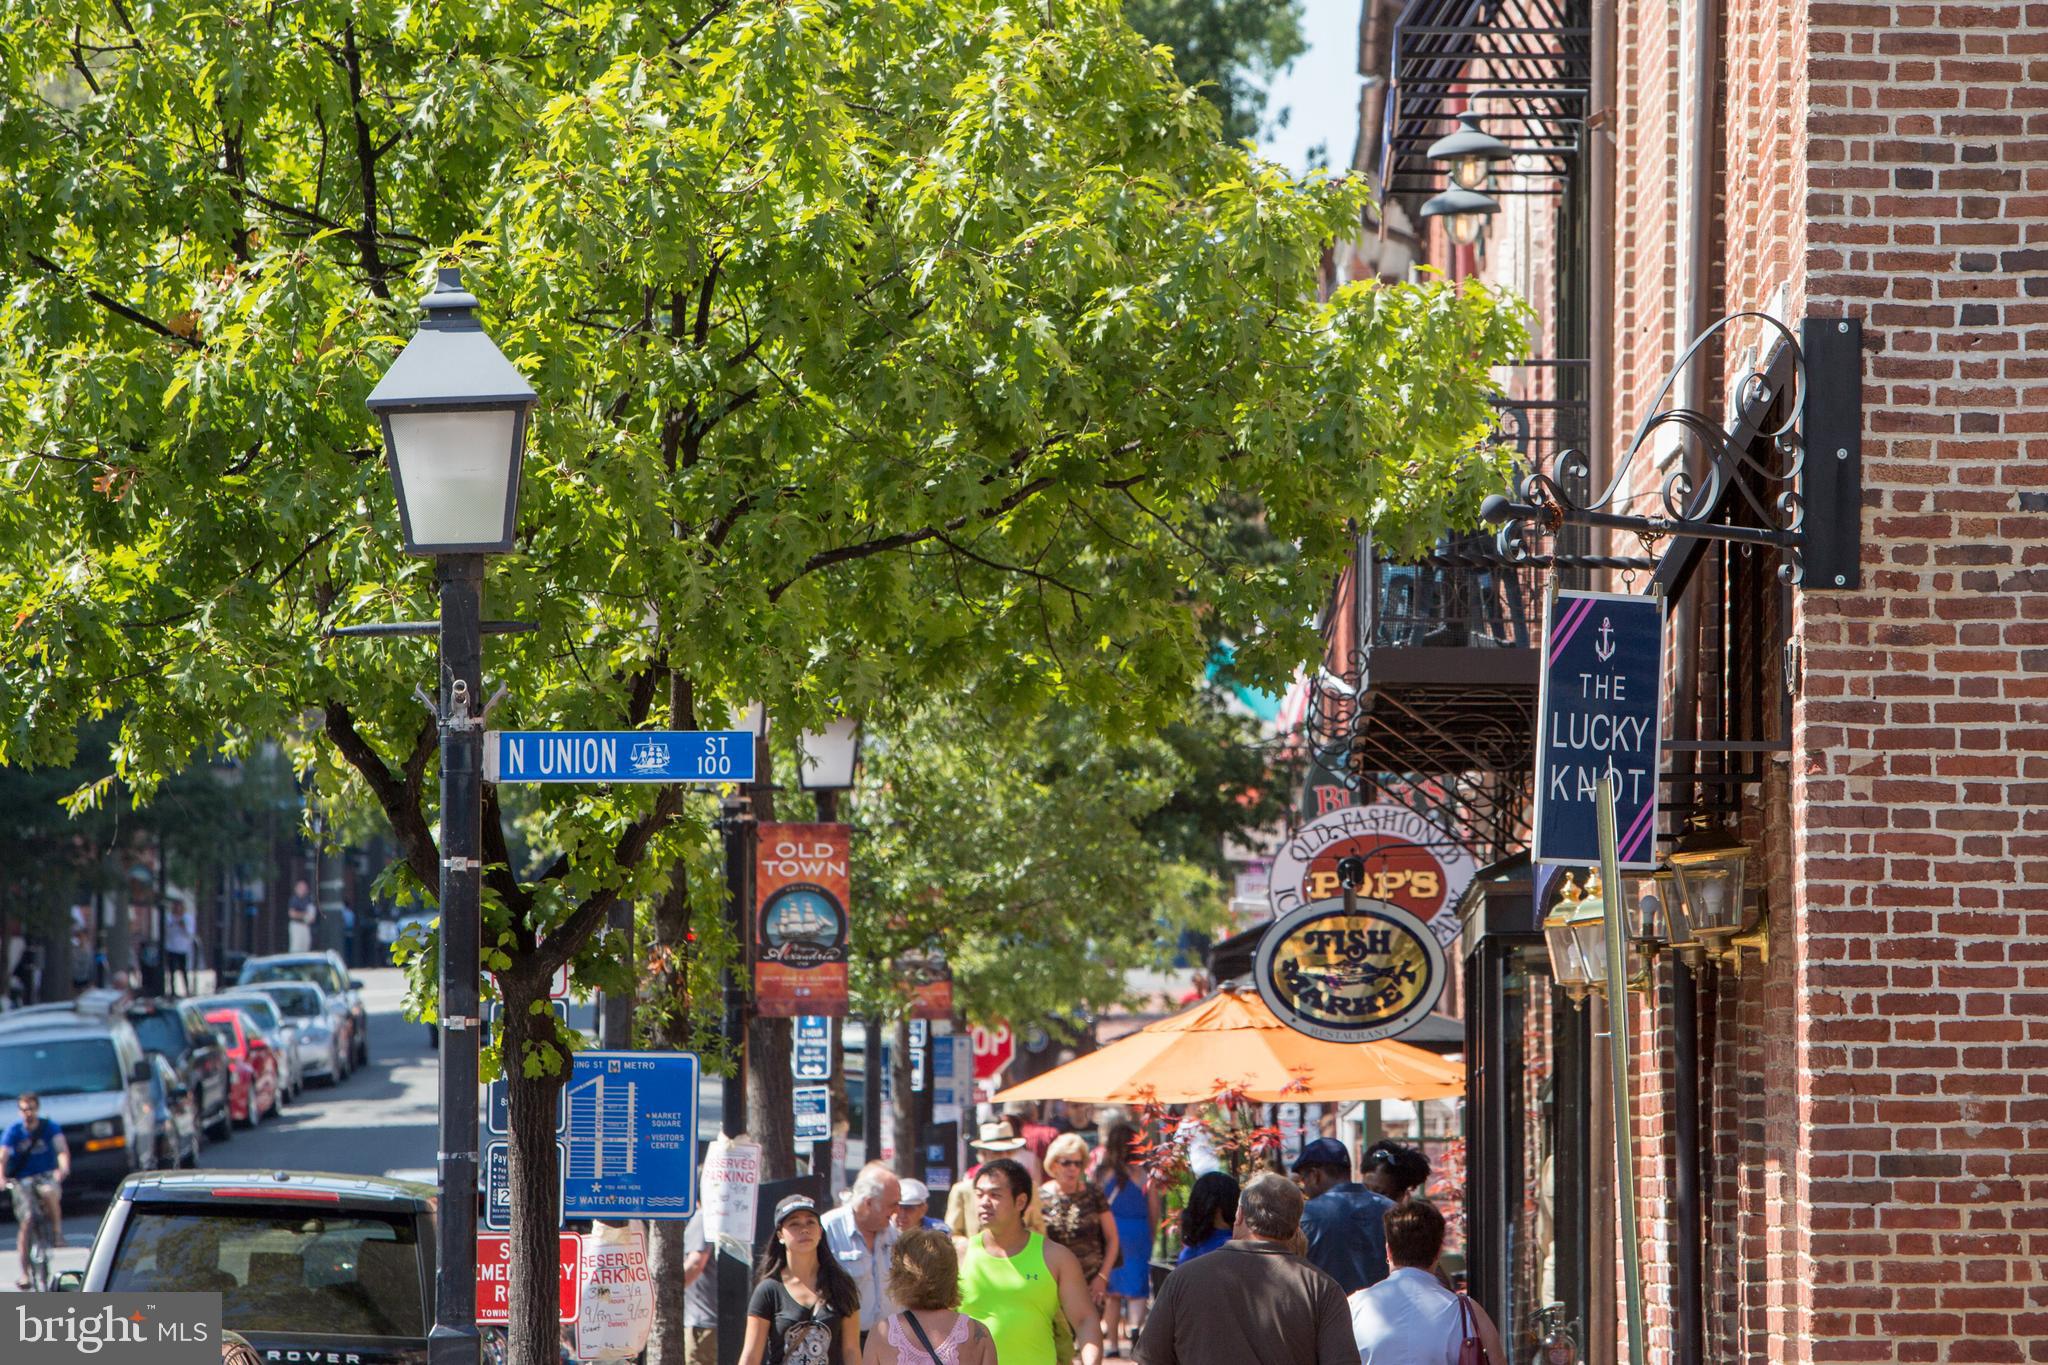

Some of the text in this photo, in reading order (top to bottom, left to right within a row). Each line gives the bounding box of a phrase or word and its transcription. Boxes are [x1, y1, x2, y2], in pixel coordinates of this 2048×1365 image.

[1579, 673, 1626, 701] THE
[1552, 711, 1650, 753] LUCKY
[705, 737, 728, 755] ST
[509, 738, 617, 774] N UNION
[697, 756, 731, 774] 100
[775, 842, 834, 859] OLD
[1290, 823, 1332, 863] OLD
[761, 860, 846, 878] TOWN
[1303, 929, 1392, 963] FISH
[1310, 1026, 1393, 1040] RESTAURANT
[593, 1060, 603, 1069] ST
[623, 1061, 656, 1070] METRO
[651, 1112, 681, 1120] MARKET
[651, 1120, 681, 1128] SQUARE
[650, 1134, 685, 1142] VISITORS
[579, 1195, 646, 1206] WATERFRONT
[581, 1251, 643, 1268] RESERVED
[580, 1267, 647, 1285] PARKING
[481, 1309, 510, 1317] TOWIN
[266, 1350, 360, 1364] ROVER
